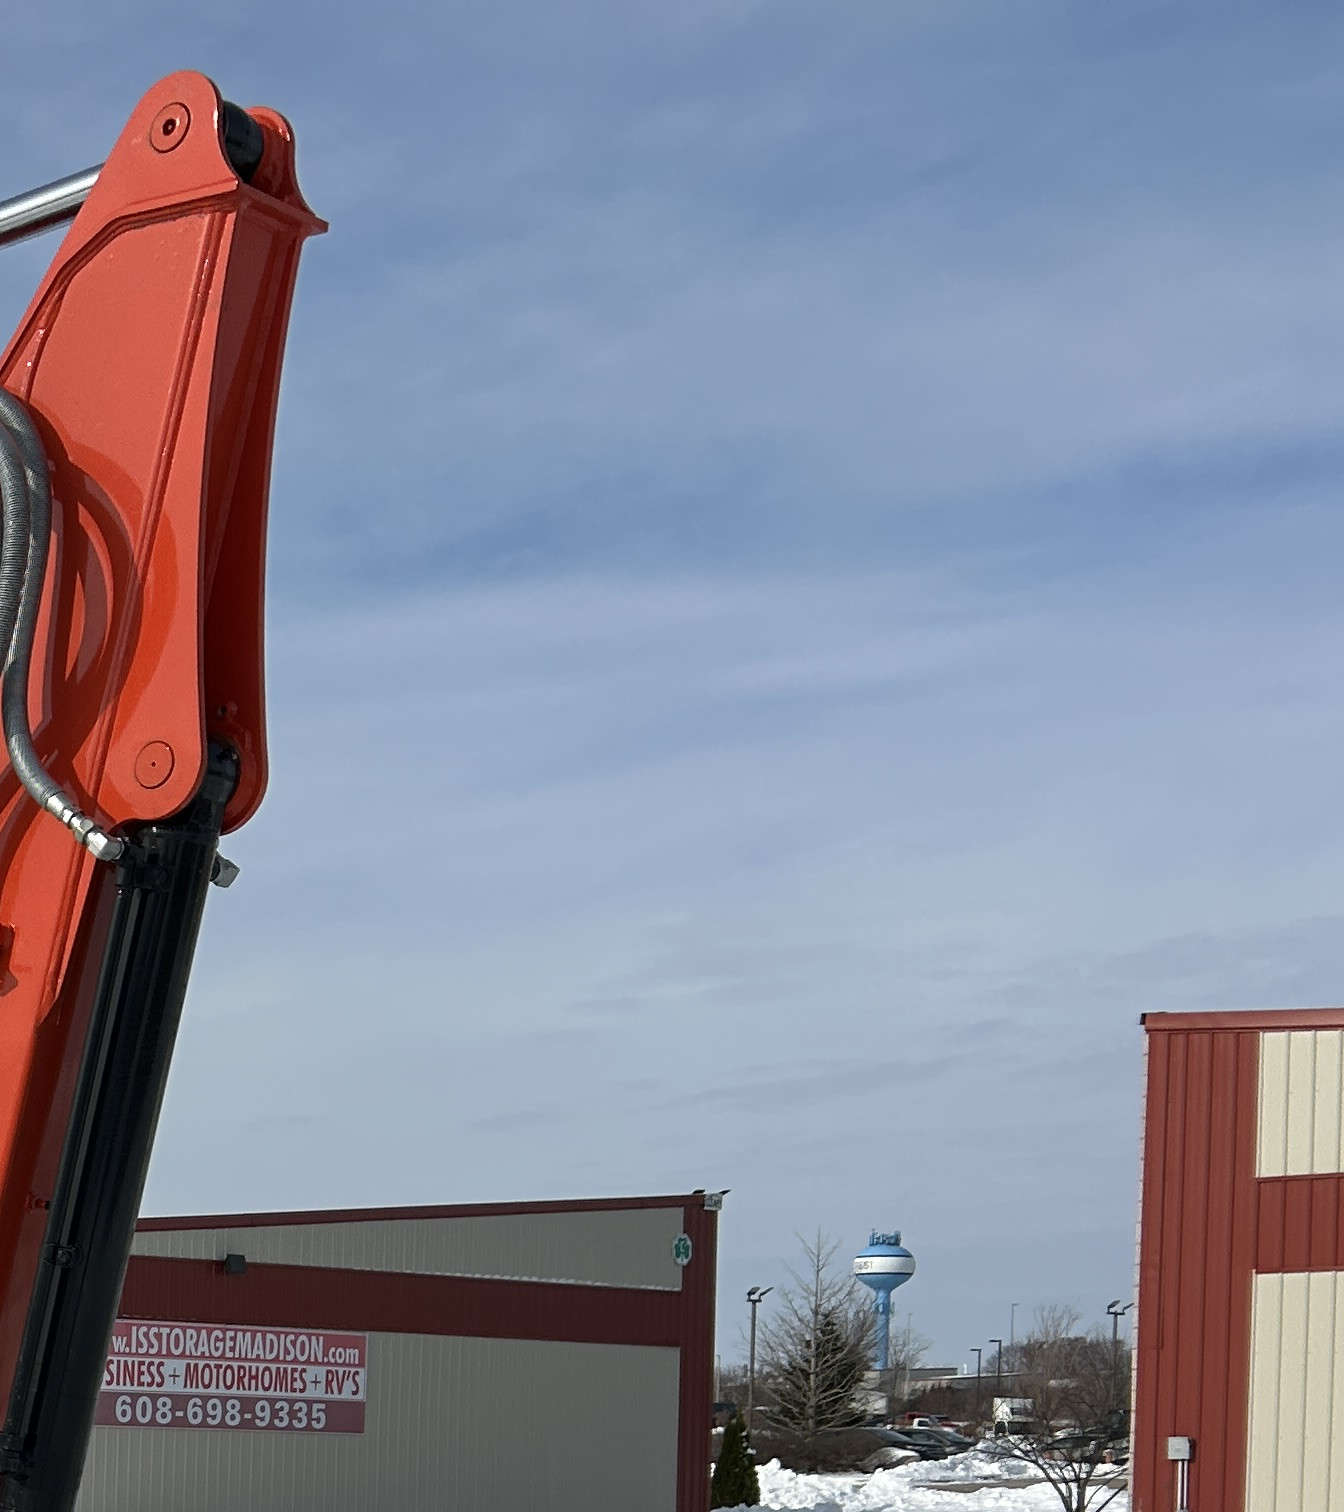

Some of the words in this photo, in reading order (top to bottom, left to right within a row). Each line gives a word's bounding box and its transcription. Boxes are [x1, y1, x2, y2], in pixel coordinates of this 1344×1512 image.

[112, 1325, 359, 1365] w.ISSTORAGEMADISON.com
[105, 1358, 165, 1387] SINESS
[183, 1363, 307, 1394] MOTORHOMES
[324, 1368, 360, 1396] RV'S
[115, 1395, 327, 1429] 608-698-9335
